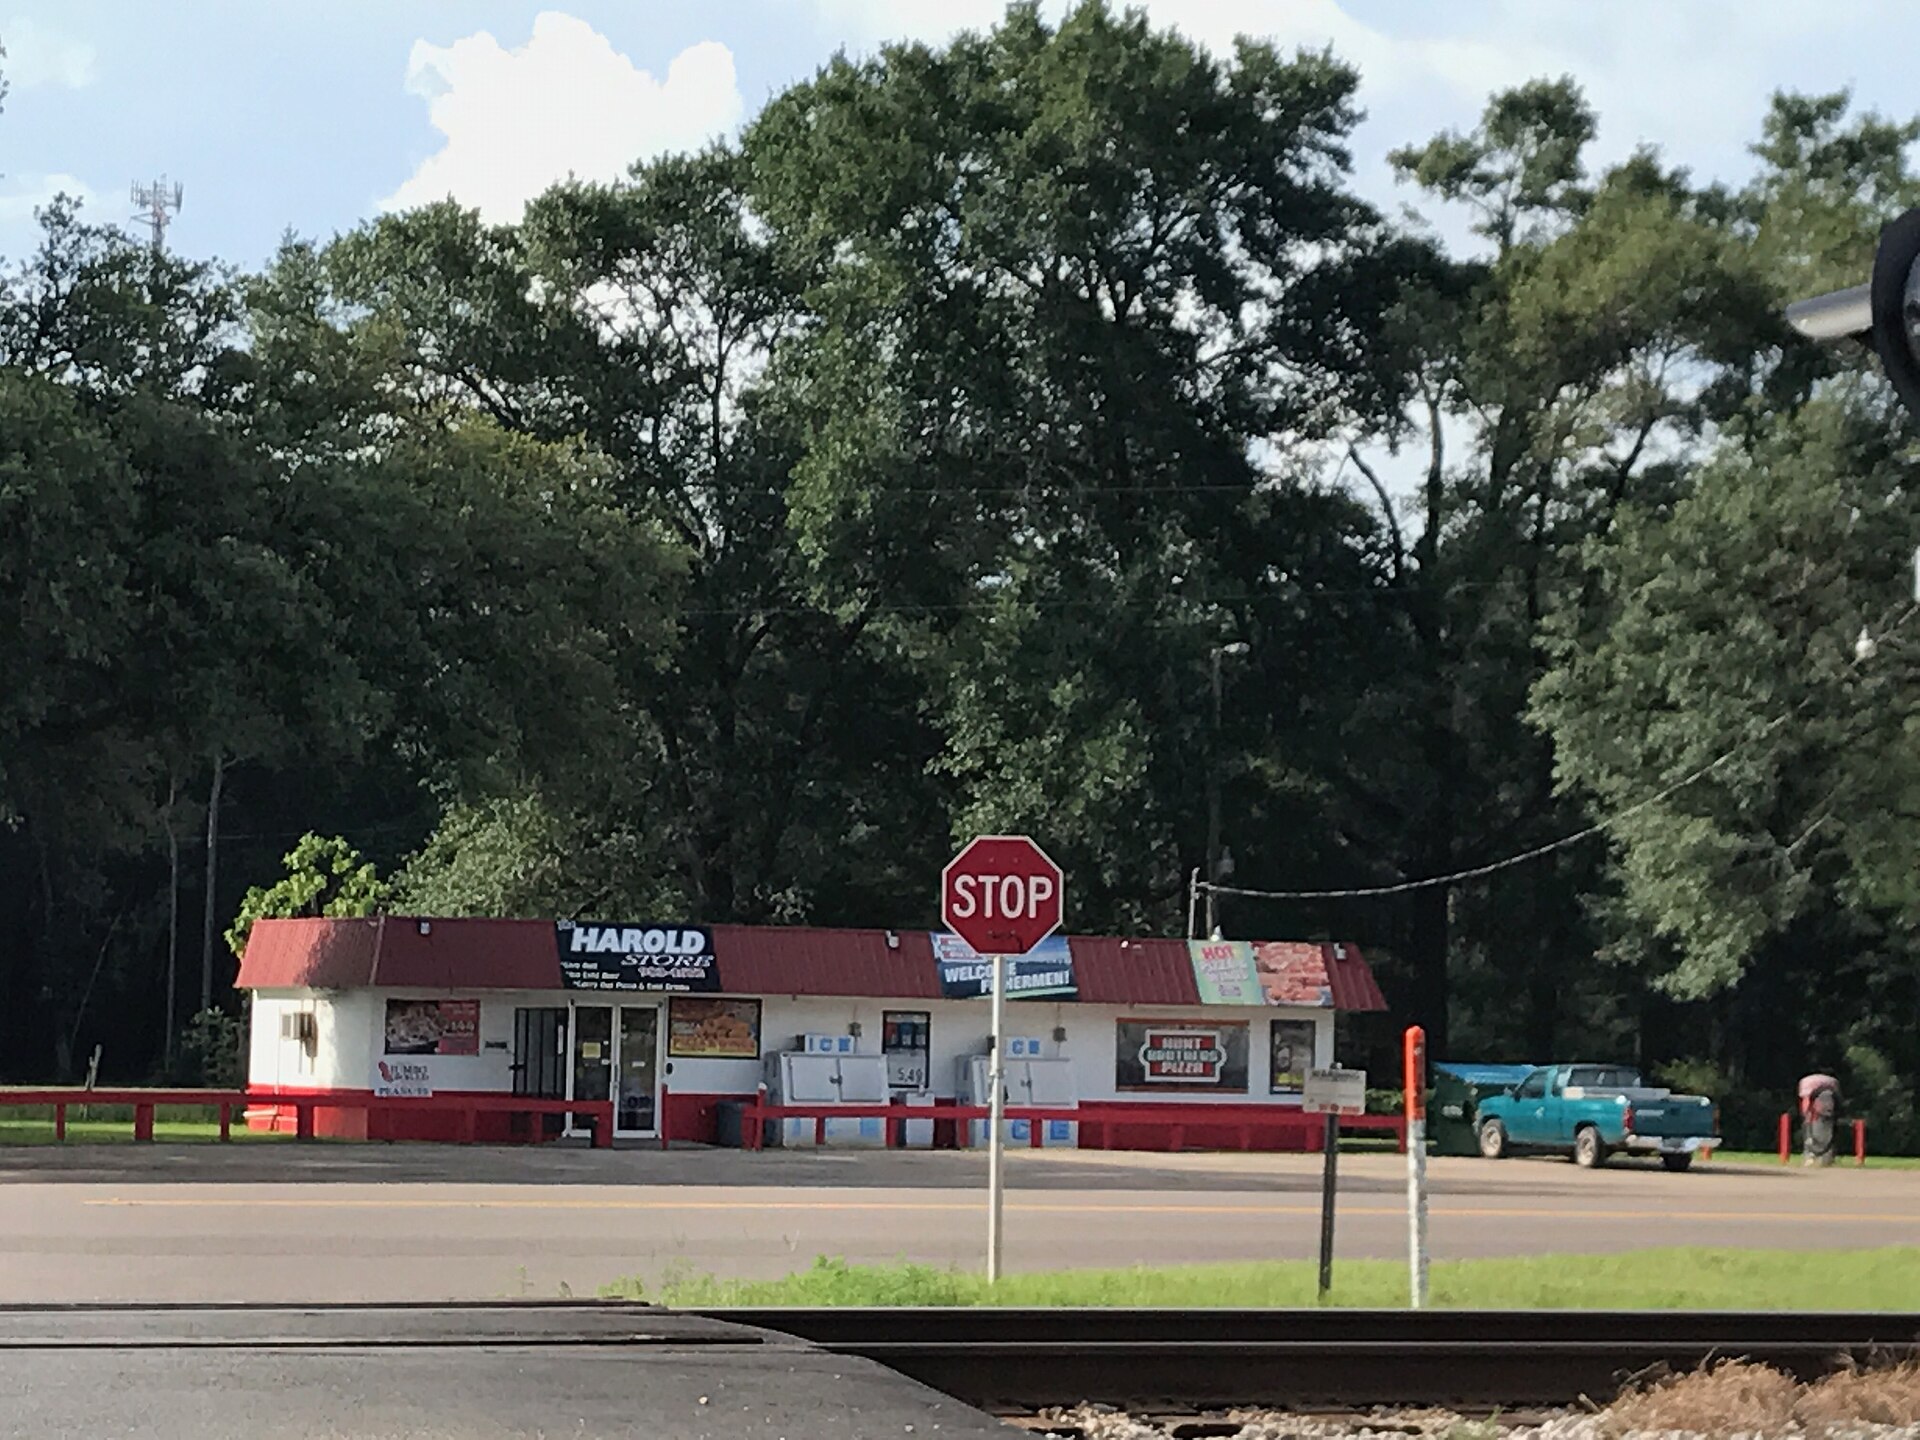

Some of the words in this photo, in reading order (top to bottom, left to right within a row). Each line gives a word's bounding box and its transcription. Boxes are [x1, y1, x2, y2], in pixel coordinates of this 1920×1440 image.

[952, 874, 1053, 919] STOP
[570, 927, 706, 954] HAROLD
[621, 954, 715, 967] STORE
[1202, 944, 1234, 960] HOT
[944, 962, 1017, 983] WELCOE
[809, 1038, 850, 1052] ICE
